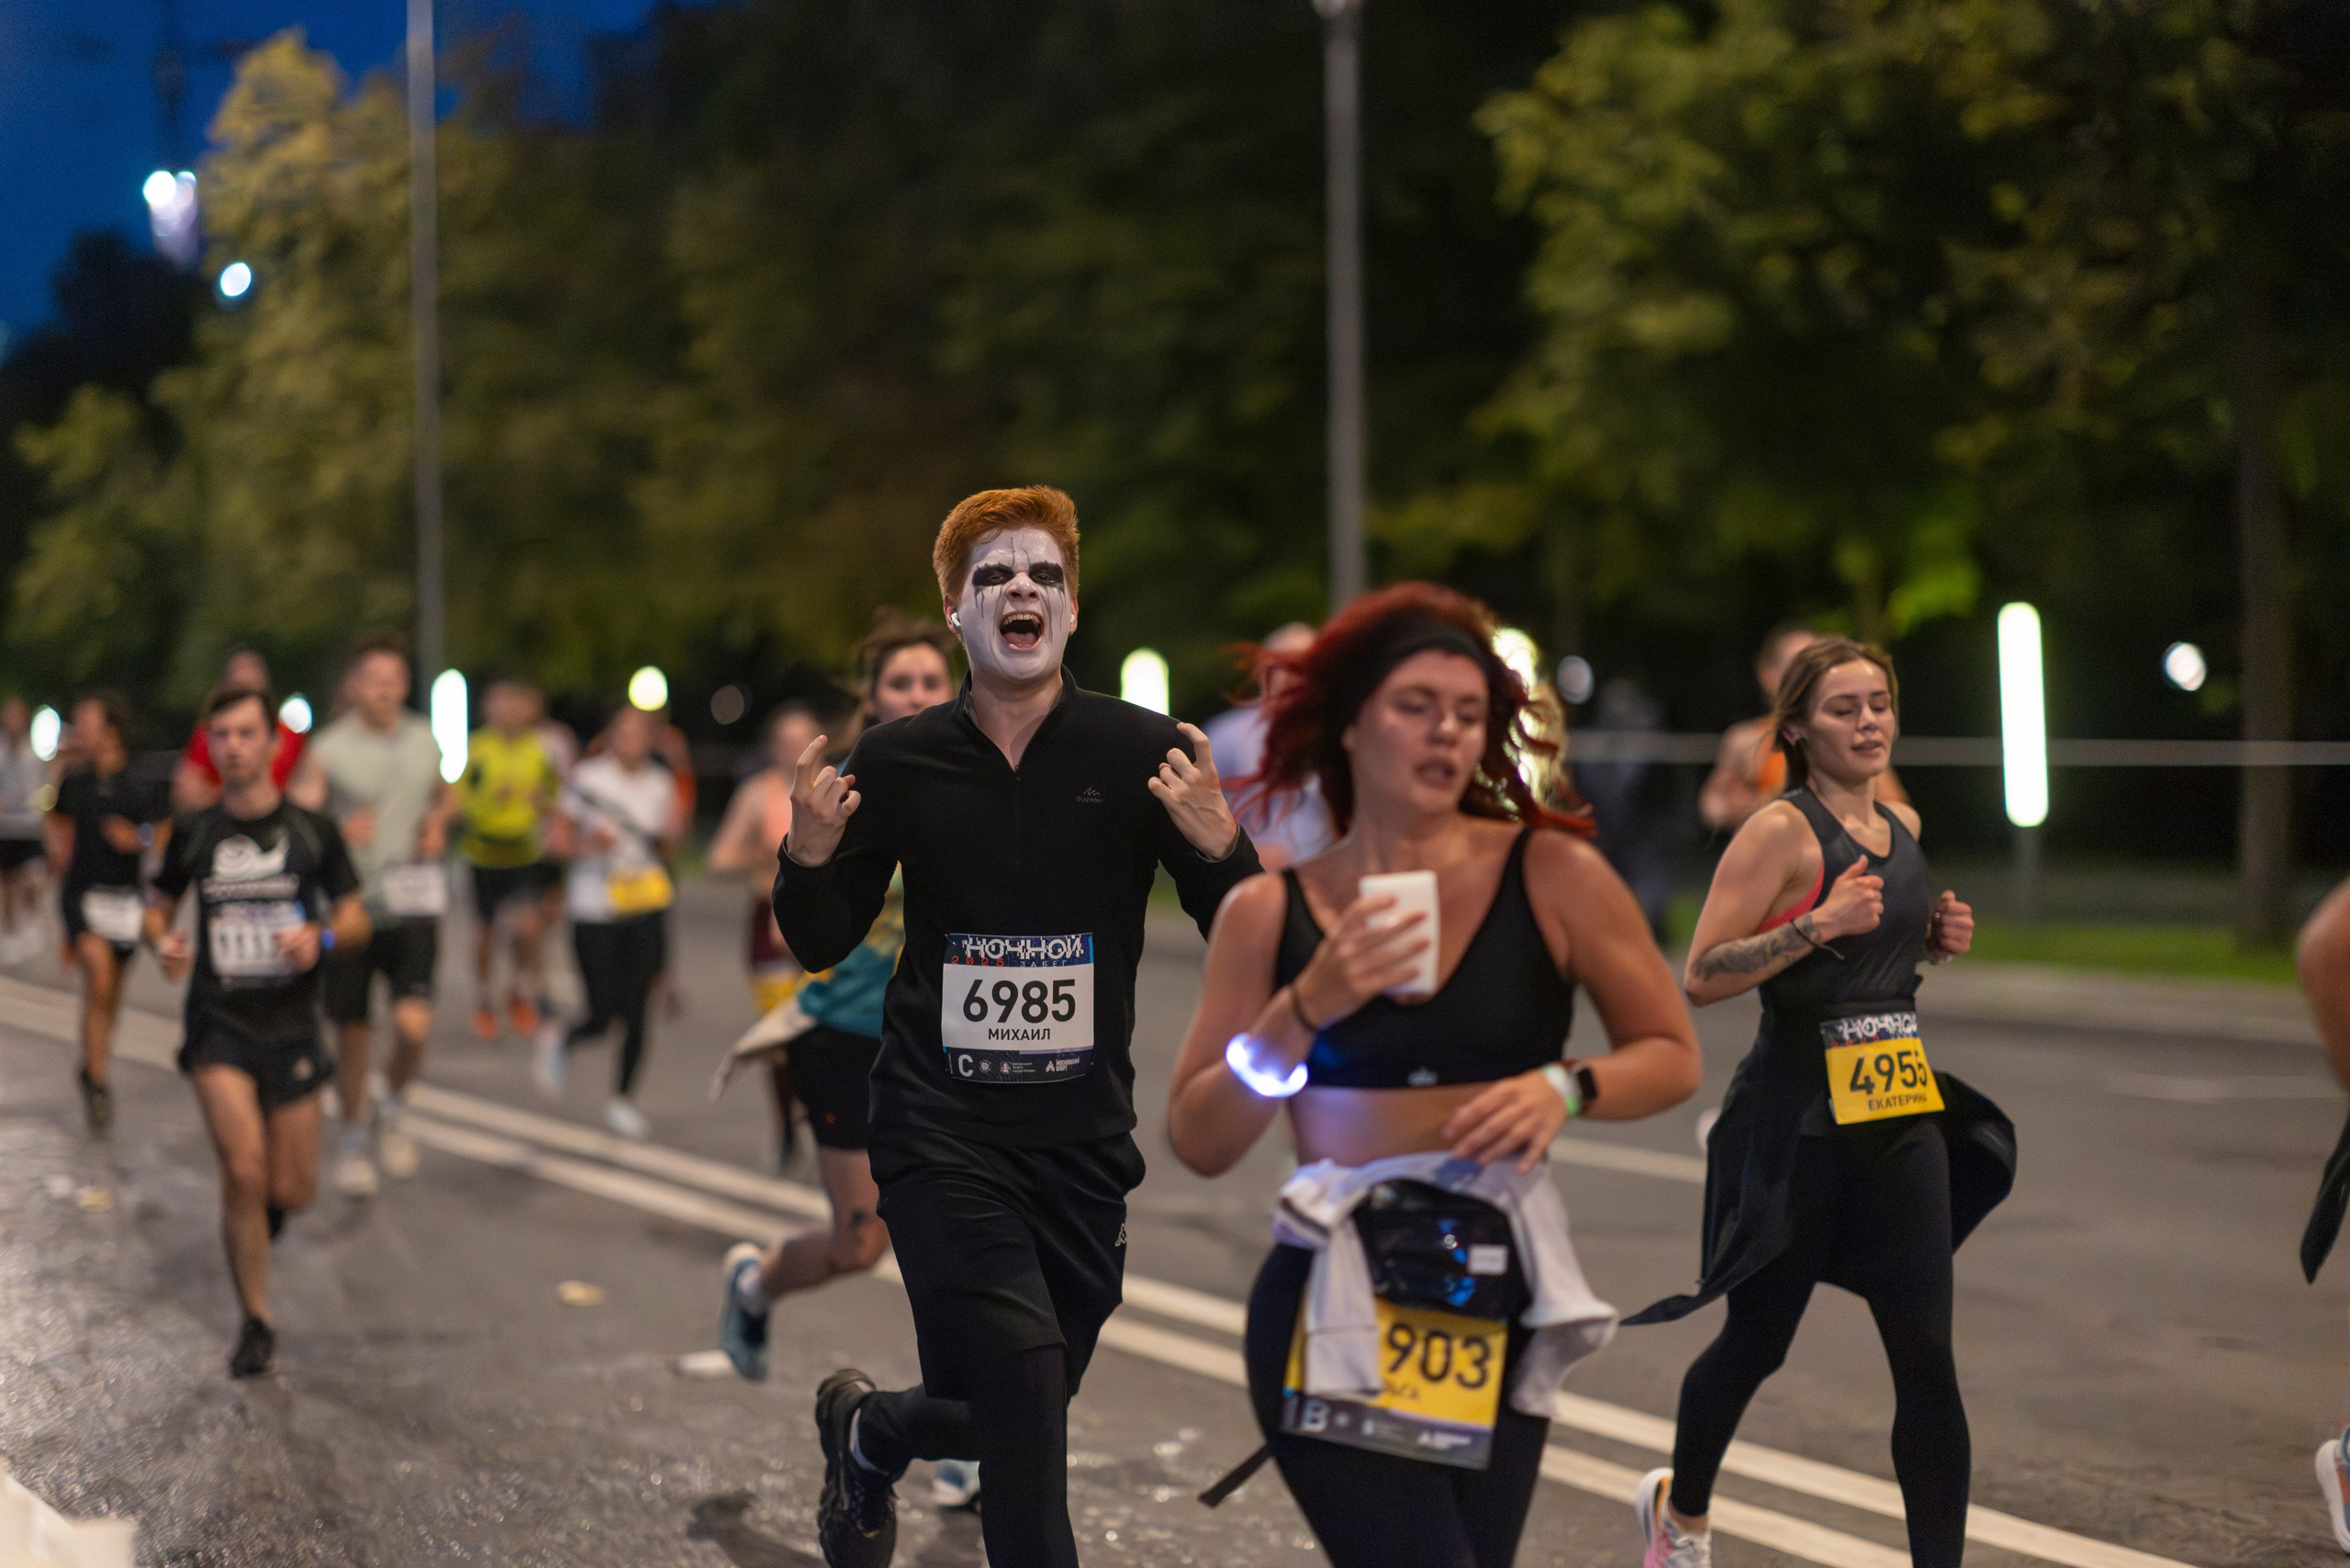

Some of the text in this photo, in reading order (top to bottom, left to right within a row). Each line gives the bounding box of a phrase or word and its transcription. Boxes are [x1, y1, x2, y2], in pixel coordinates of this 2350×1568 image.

[951, 955, 1004, 967] 2025
[962, 935, 1084, 959] НОЧНОЙ
[963, 979, 1076, 1024] 6985
[988, 1028, 1050, 1040] МИХАИЛ
[1388, 1322, 1491, 1389] 903
[1298, 1400, 1328, 1432] B
